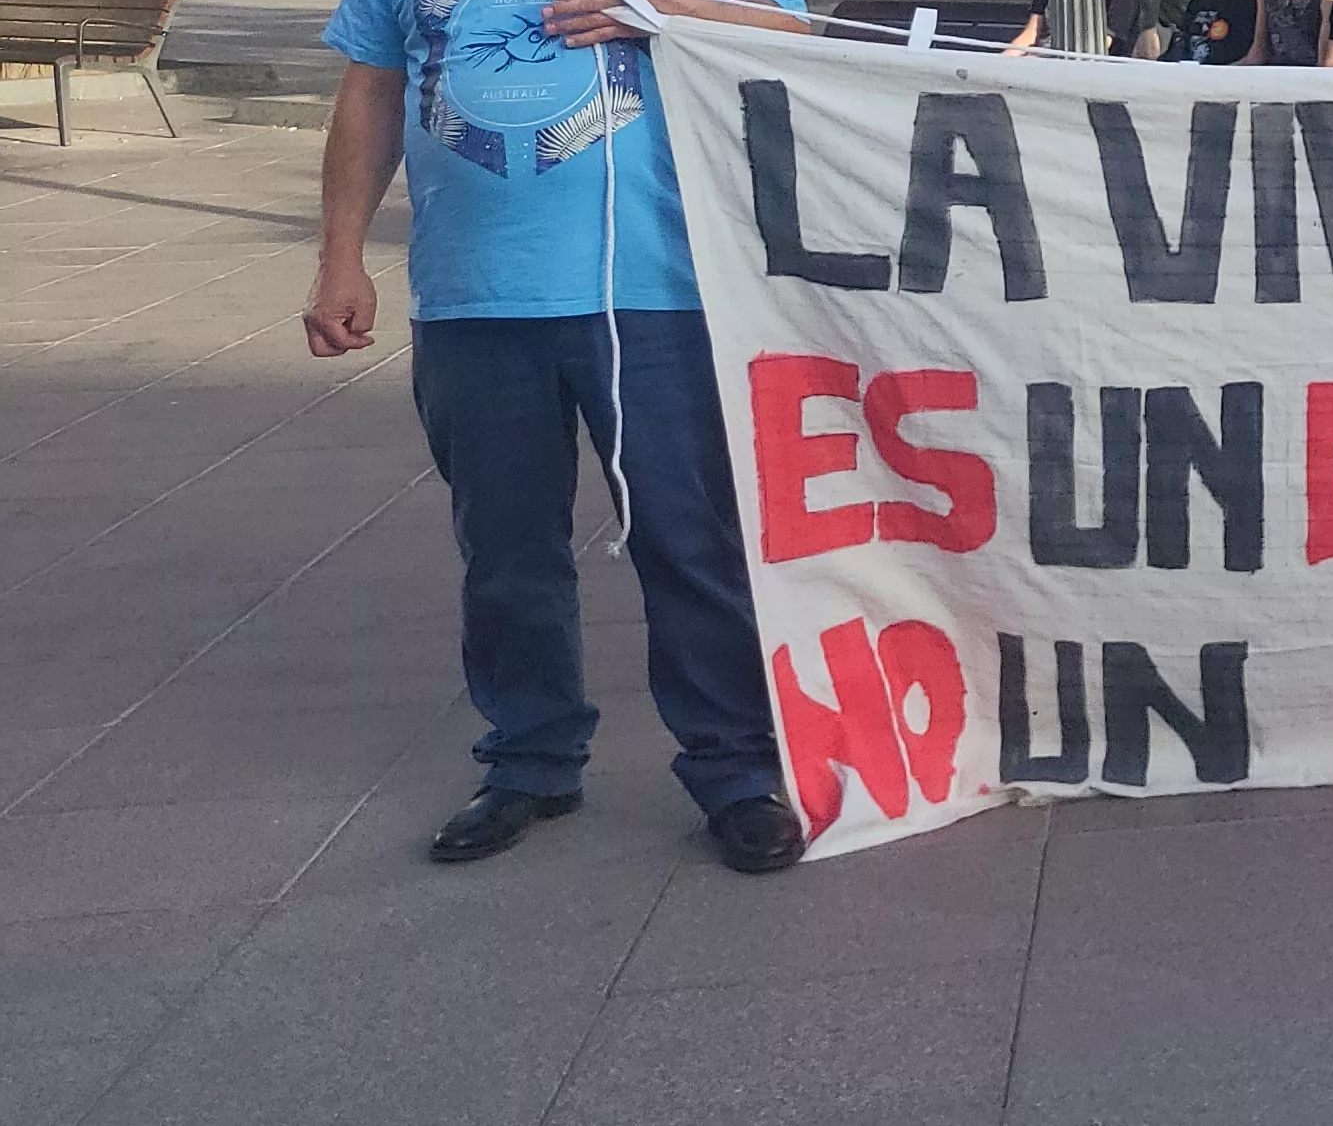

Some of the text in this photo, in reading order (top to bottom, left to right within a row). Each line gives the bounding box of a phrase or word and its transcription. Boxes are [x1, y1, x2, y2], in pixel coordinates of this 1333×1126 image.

[483, 89, 548, 100] AUSTRALIA
[739, 78, 1048, 303] LA
[748, 351, 997, 564] ES
[1027, 382, 1263, 572] UN
[773, 616, 966, 844] NO
[997, 631, 1249, 787] UN
